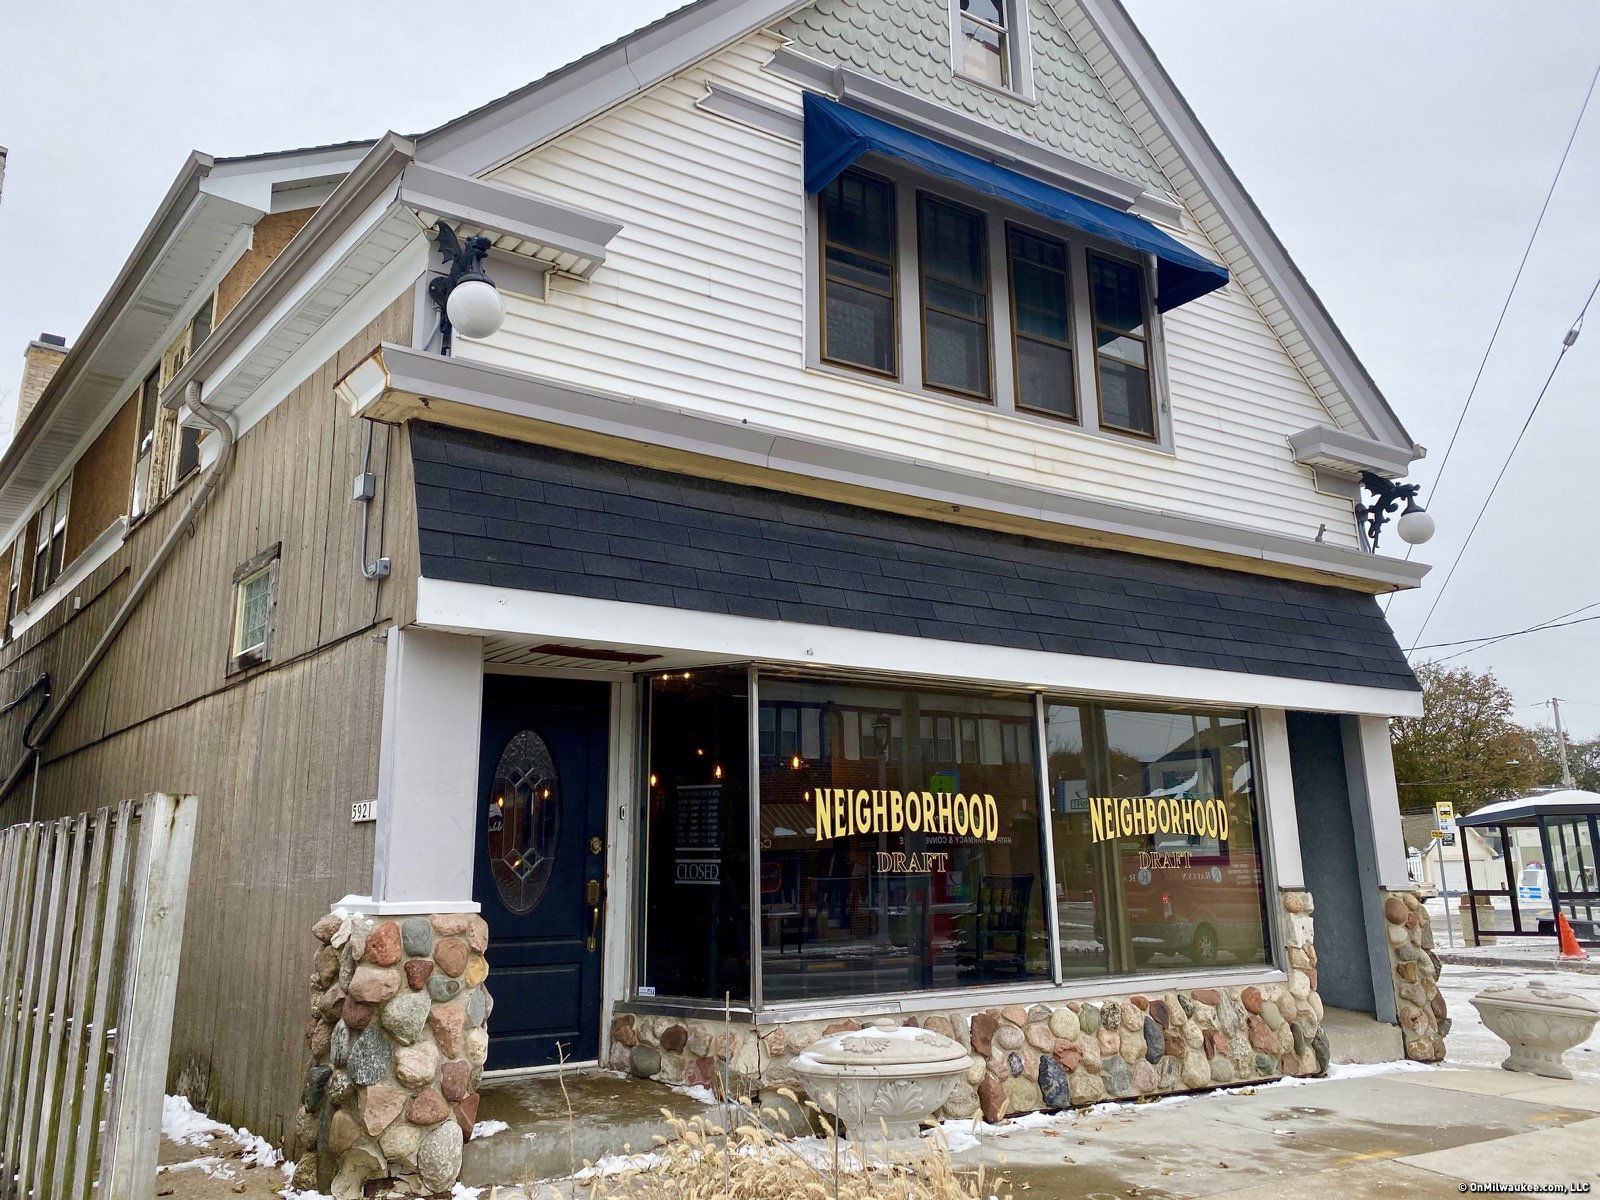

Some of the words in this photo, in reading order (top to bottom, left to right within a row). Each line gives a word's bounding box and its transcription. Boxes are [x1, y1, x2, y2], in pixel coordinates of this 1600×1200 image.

[352, 802, 372, 819] 5921
[814, 788, 999, 842] NEIGHBORHOOD
[1088, 797, 1229, 843] NEIGHBORHOOD
[876, 851, 948, 873] DRAFT
[1139, 851, 1193, 869] DRAFT
[676, 863, 719, 880] CLOSED
